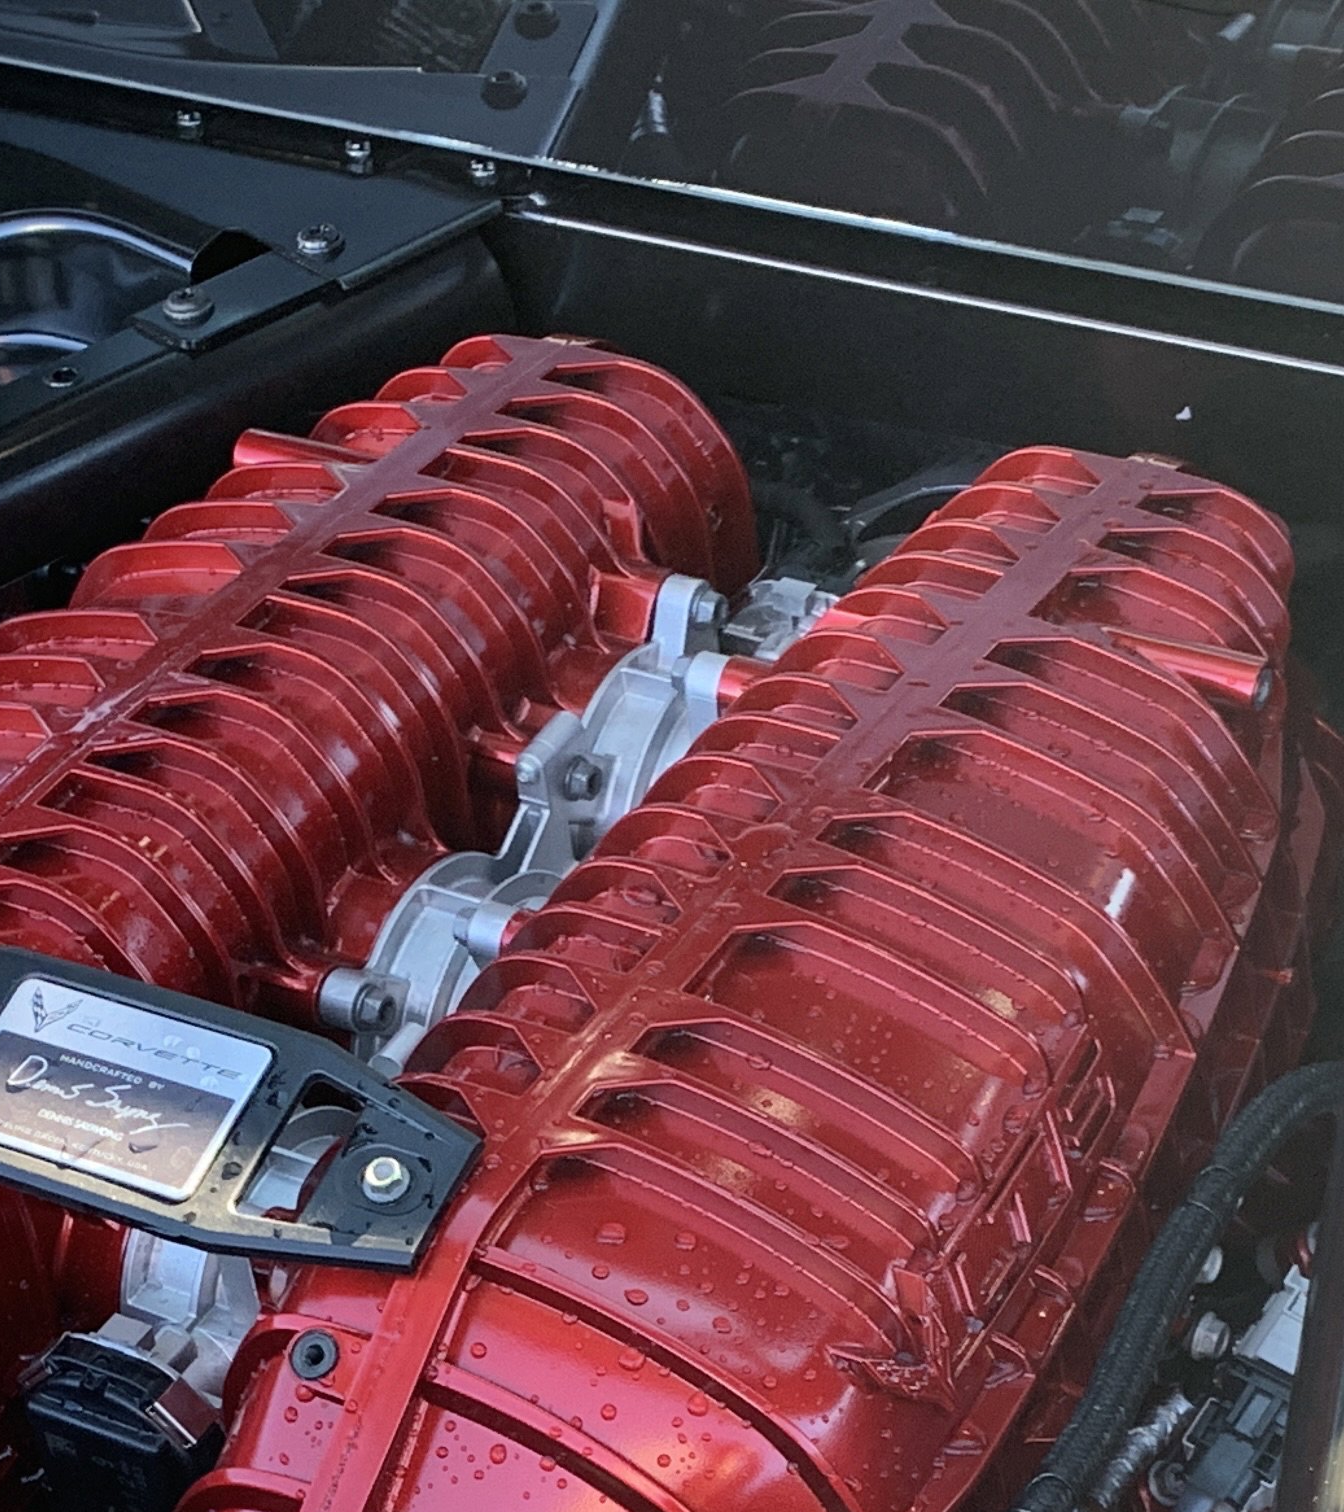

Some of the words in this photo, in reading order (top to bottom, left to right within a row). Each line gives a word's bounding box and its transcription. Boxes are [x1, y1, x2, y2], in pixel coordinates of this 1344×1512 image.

[67, 1023, 244, 1081] CORVETTE
[59, 1054, 143, 1085] HANDCRAFTED
[148, 1080, 166, 1092] BY
[37, 1108, 75, 1127] DENNIS
